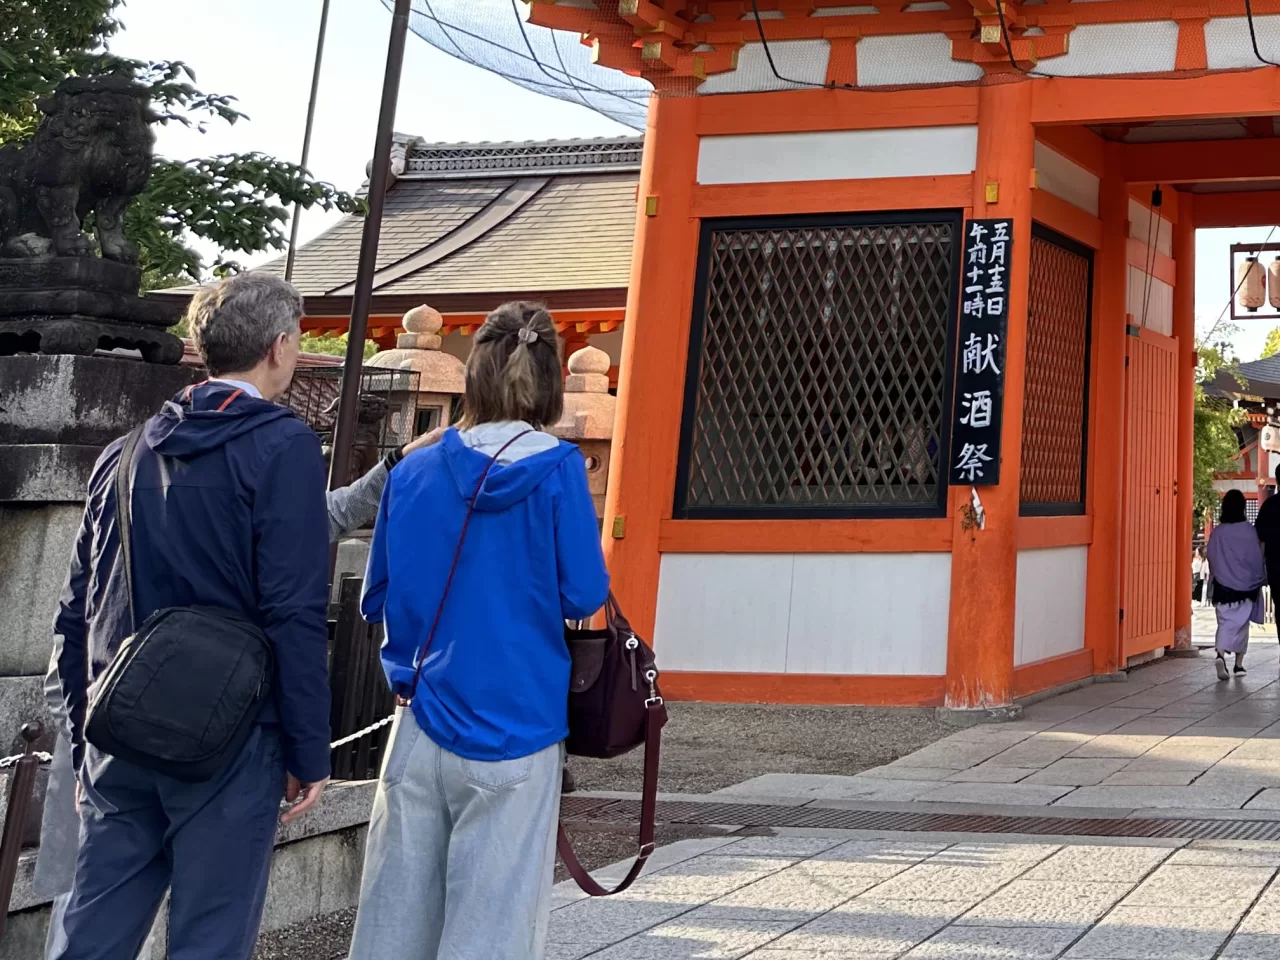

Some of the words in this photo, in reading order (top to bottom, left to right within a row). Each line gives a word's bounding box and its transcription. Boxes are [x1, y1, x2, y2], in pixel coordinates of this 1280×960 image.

[963, 222, 988, 319] 午前十一時
[985, 221, 1010, 316] 五月十五日
[954, 332, 1001, 482] 献酒祭
